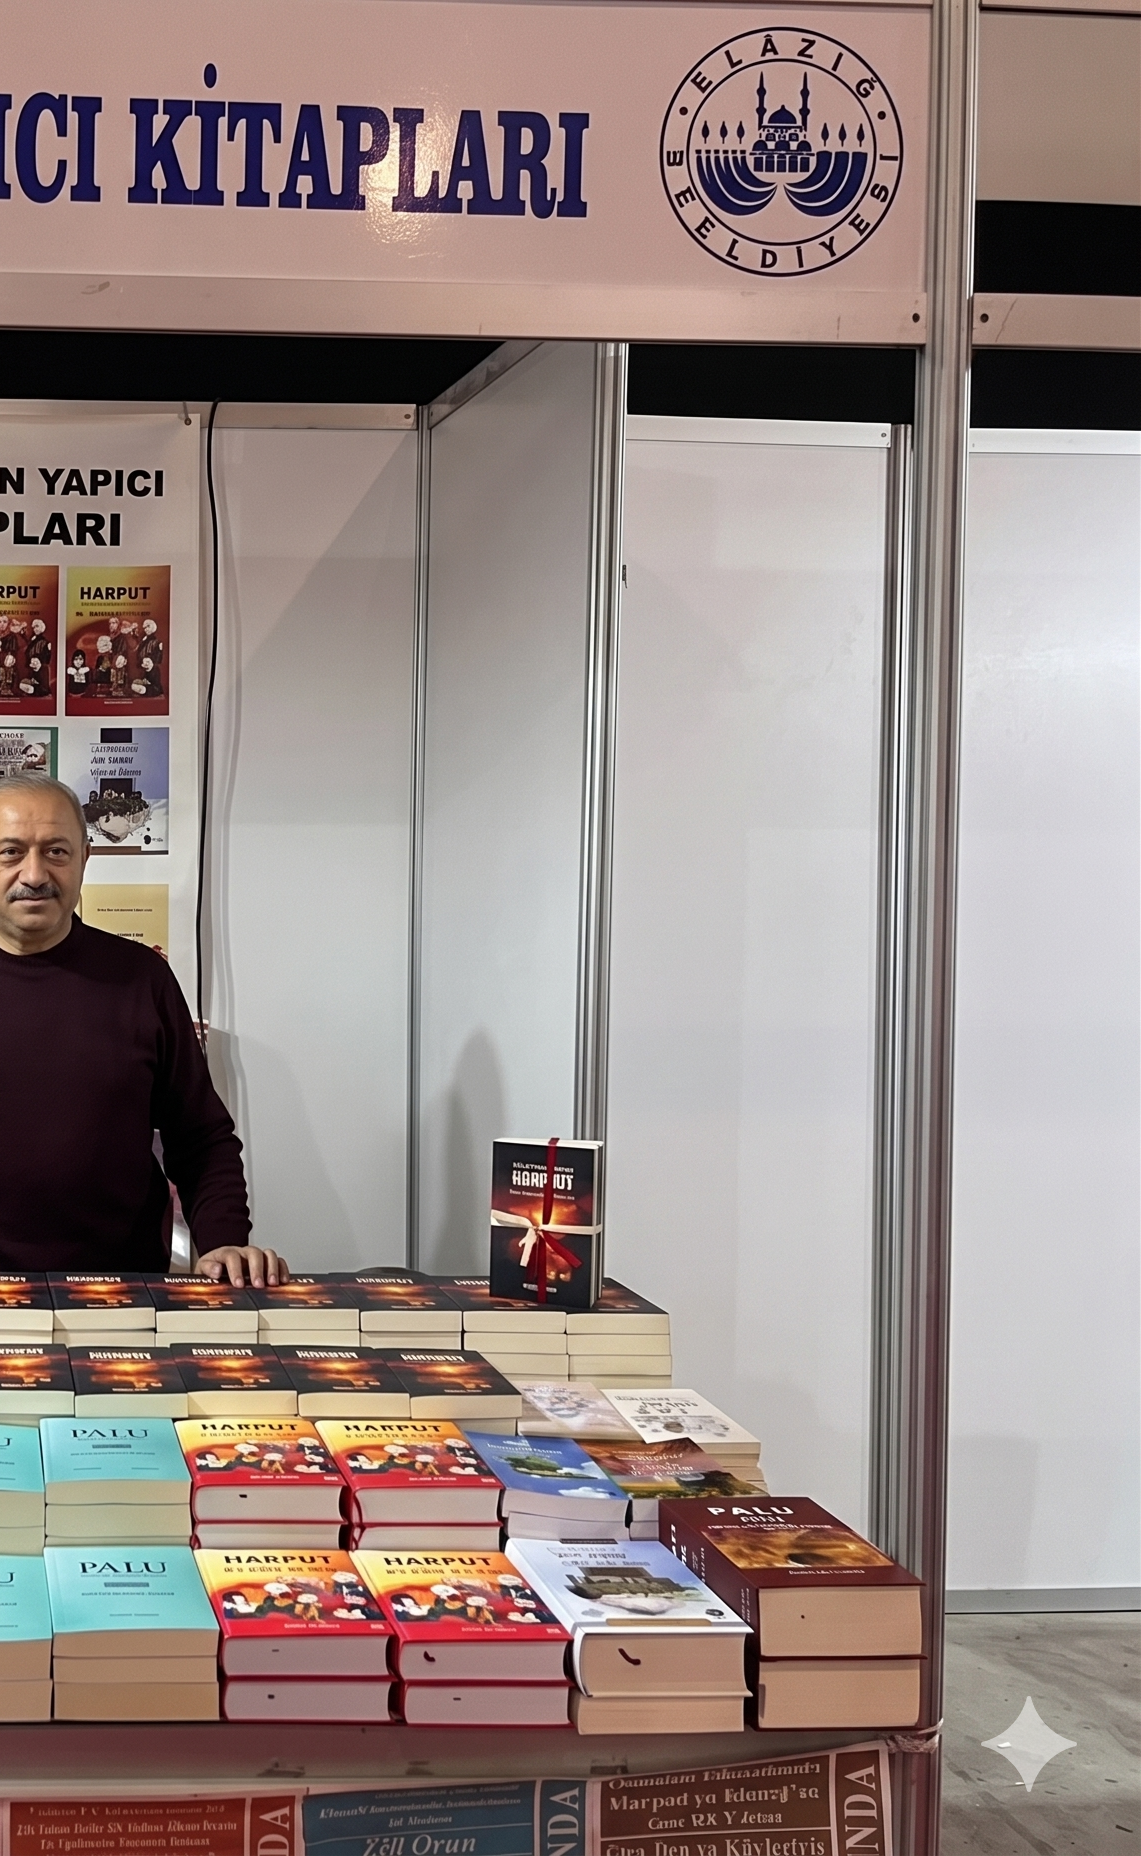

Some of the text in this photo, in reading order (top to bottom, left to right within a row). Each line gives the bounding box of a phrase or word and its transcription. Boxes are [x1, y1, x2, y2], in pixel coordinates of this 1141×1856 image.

[127, 62, 590, 219] KİTAPLARI
[37, 467, 164, 498] YAPICI
[79, 586, 151, 600] HARPUT
[201, 1423, 298, 1432] HARPUT
[343, 1424, 442, 1433] HARPUT
[70, 1428, 149, 1439] PALU
[706, 1506, 795, 1516] PALU
[224, 1554, 332, 1565] HARPUT
[384, 1556, 492, 1567] HARPUT
[79, 1561, 168, 1574] PALU
[843, 1763, 880, 1856] NDA
